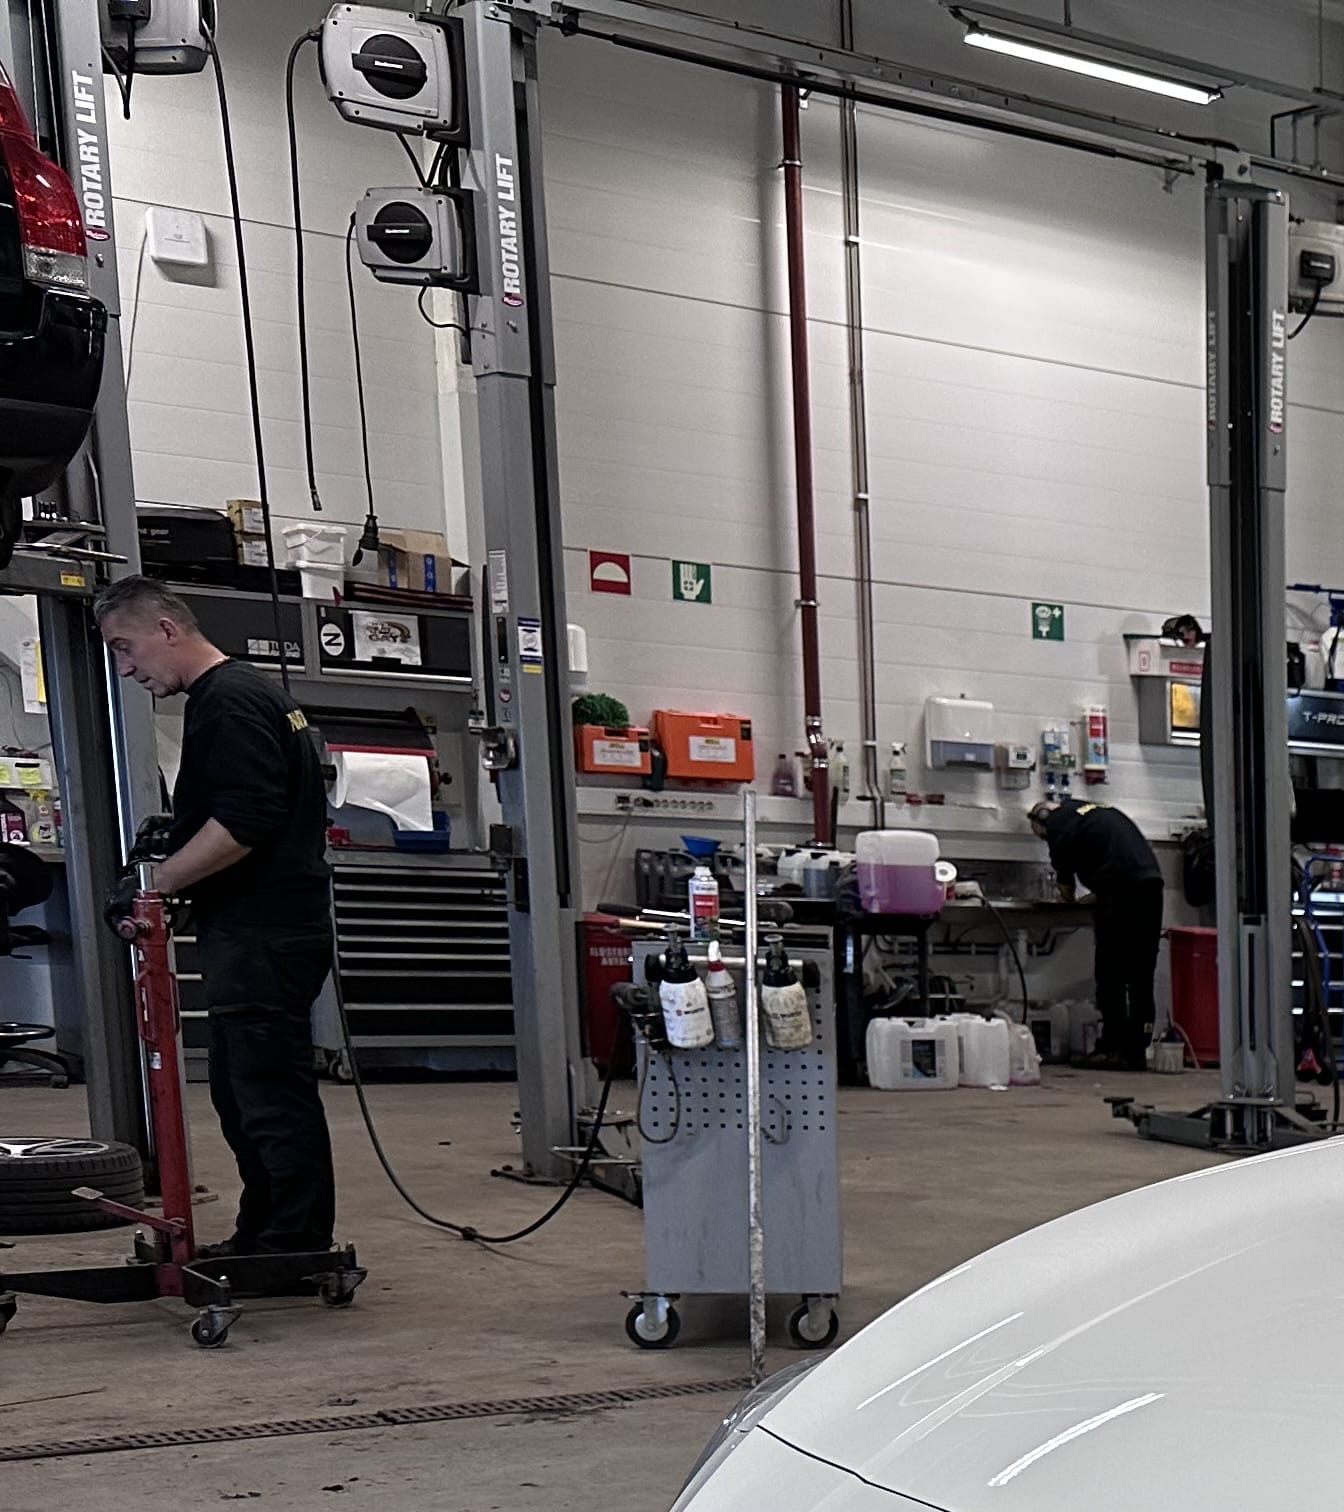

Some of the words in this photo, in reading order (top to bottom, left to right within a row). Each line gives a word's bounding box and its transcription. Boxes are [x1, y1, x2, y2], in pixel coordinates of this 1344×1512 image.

[72, 70, 97, 123] LIFT
[77, 128, 106, 228] ROTARY
[495, 153, 515, 201] LIFT
[498, 205, 521, 294] ROTARY
[1271, 309, 1285, 348] LIFT
[1270, 351, 1284, 423] ROTARY
